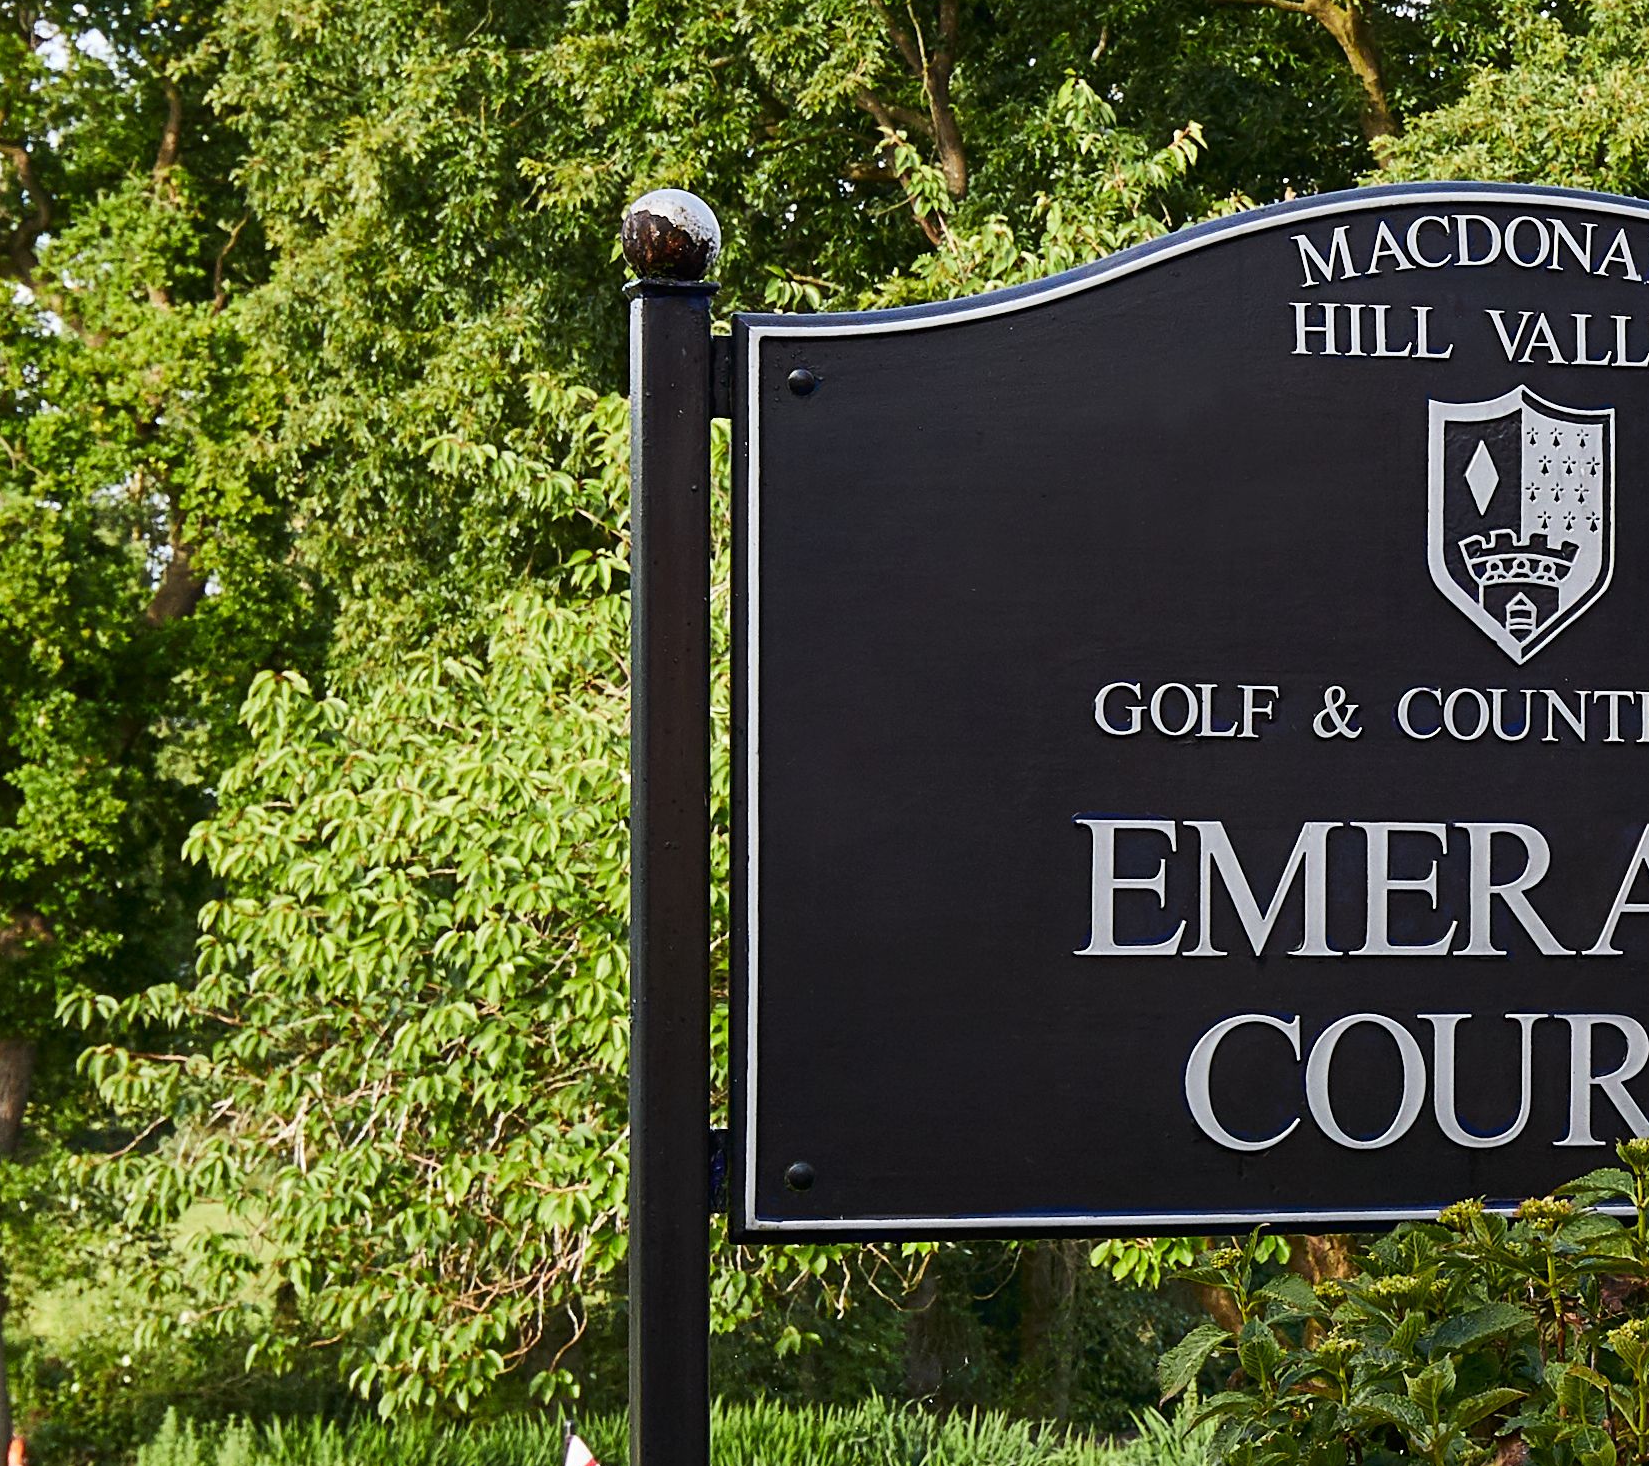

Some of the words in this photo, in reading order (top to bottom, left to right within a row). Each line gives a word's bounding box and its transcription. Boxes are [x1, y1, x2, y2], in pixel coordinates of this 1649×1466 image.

[1289, 303, 1453, 358] HILL
[1095, 682, 1279, 737] GOLF
[1313, 686, 1362, 738] &
